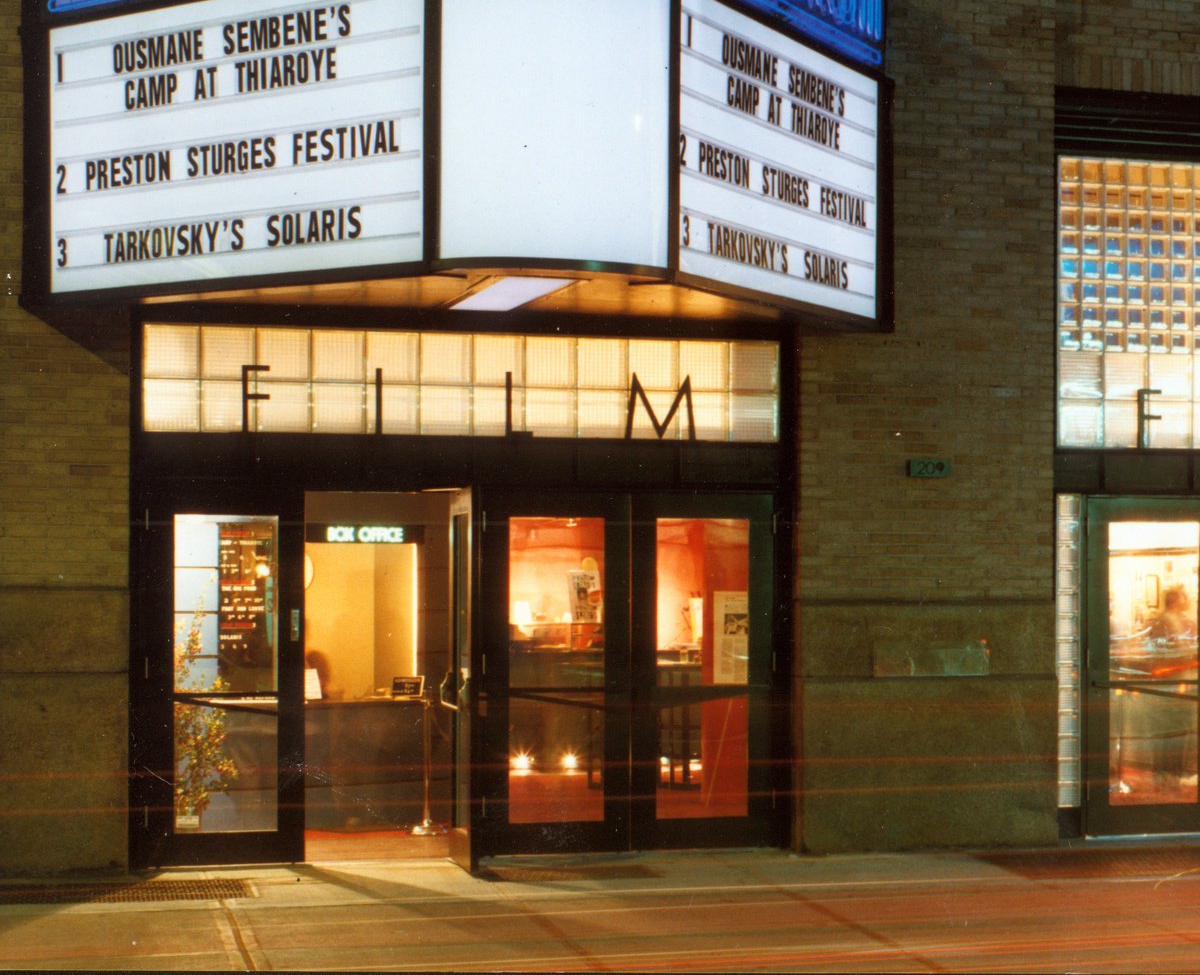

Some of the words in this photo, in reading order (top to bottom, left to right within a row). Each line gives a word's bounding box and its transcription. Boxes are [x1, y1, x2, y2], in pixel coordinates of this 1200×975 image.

[56, 53, 64, 83] 1
[112, 29, 203, 74] OUSMANE
[222, 4, 351, 55] SEMBENE'S
[124, 73, 178, 110] CAMP
[194, 67, 218, 101] AT
[234, 46, 337, 93] THIAROYE
[687, 15, 693, 47] 1
[722, 33, 778, 87] OUSMANE
[788, 64, 845, 118] SEMBENE'S
[727, 75, 760, 115] CAMP
[768, 93, 782, 126] AT
[791, 103, 840, 151] THIAROYE
[56, 164, 67, 194] 2
[85, 150, 171, 191] PRESTON
[187, 136, 276, 178] STURGES
[292, 120, 399, 165] FESTIVAL
[680, 134, 687, 166] 2
[698, 141, 750, 189] PRESTON
[762, 165, 809, 208] STURGES
[820, 186, 867, 227] FESTIVAL
[57, 237, 68, 267] 3
[104, 219, 244, 264] TARKOVSKY'S
[266, 206, 362, 248] SOLARIS
[683, 215, 690, 246] 3
[707, 222, 788, 275] TARKOVSKY'S
[803, 250, 849, 289] SOLARIS
[241, 365, 696, 440] FILM
[326, 525, 355, 542] BOX
[358, 525, 404, 543] OFFICE
